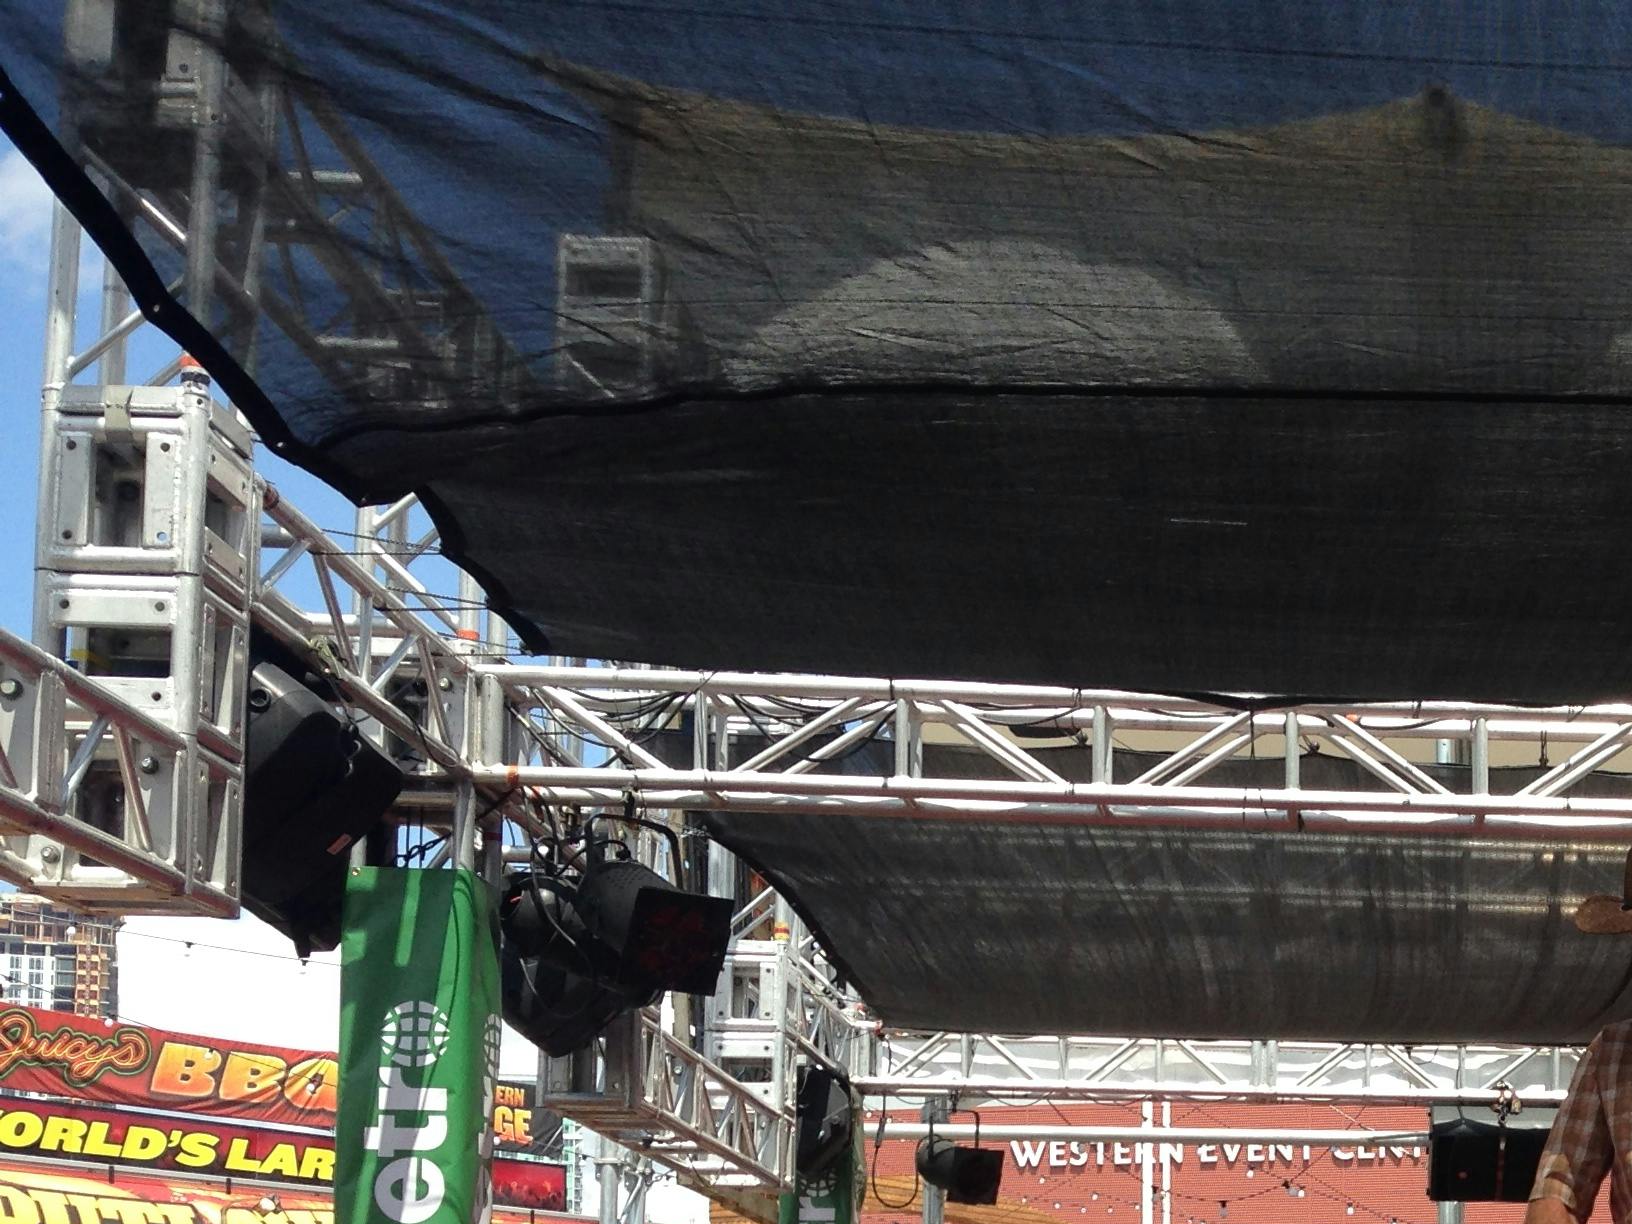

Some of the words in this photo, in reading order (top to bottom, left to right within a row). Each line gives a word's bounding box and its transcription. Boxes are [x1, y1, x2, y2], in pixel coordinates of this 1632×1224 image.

[495, 1085, 525, 1107] ERN
[493, 1106, 534, 1146] GE
[0, 1110, 220, 1168] ORLD'S
[225, 1138, 336, 1181] LAR
[1010, 1140, 1184, 1168] WESTERN
[1200, 1143, 1311, 1164] EVENT
[1333, 1143, 1421, 1160] CENT
